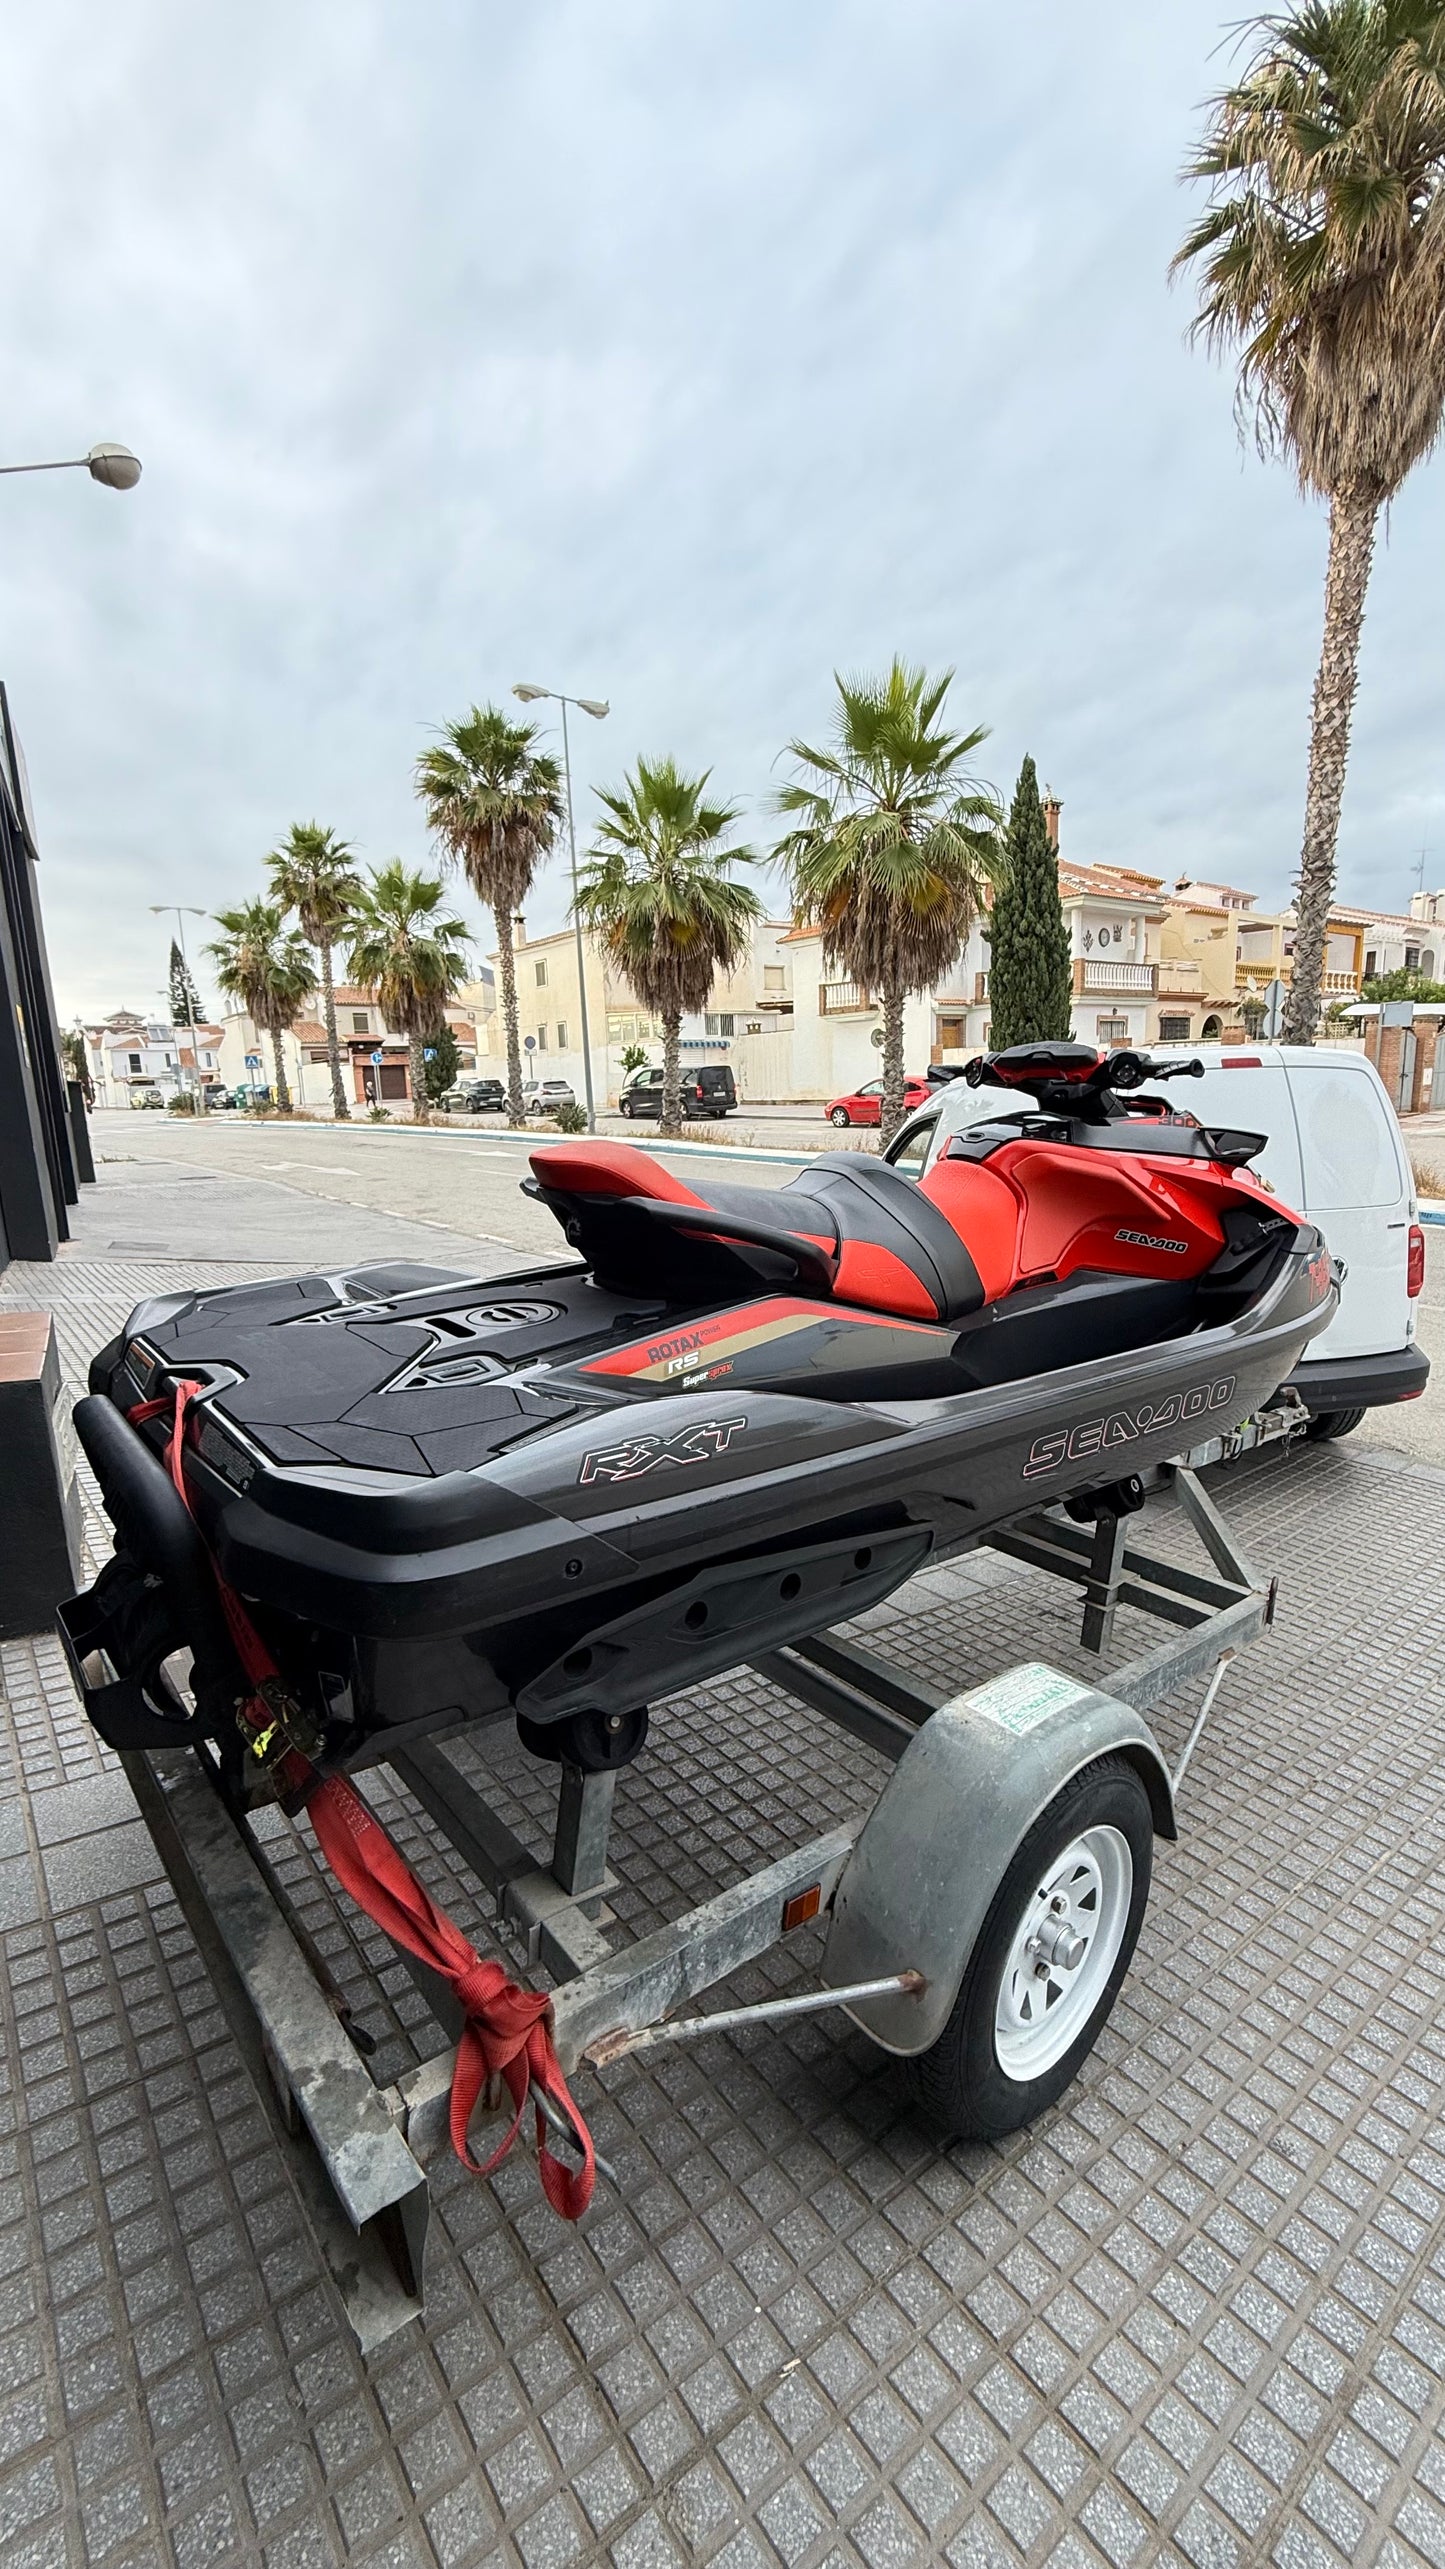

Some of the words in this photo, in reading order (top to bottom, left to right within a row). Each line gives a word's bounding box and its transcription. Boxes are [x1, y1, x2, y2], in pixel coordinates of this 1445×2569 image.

[647, 1331, 705, 1364] ROTAX
[700, 1324, 721, 1337] POWER
[668, 1351, 699, 1375] RS
[579, 1416, 747, 1484] RXT
